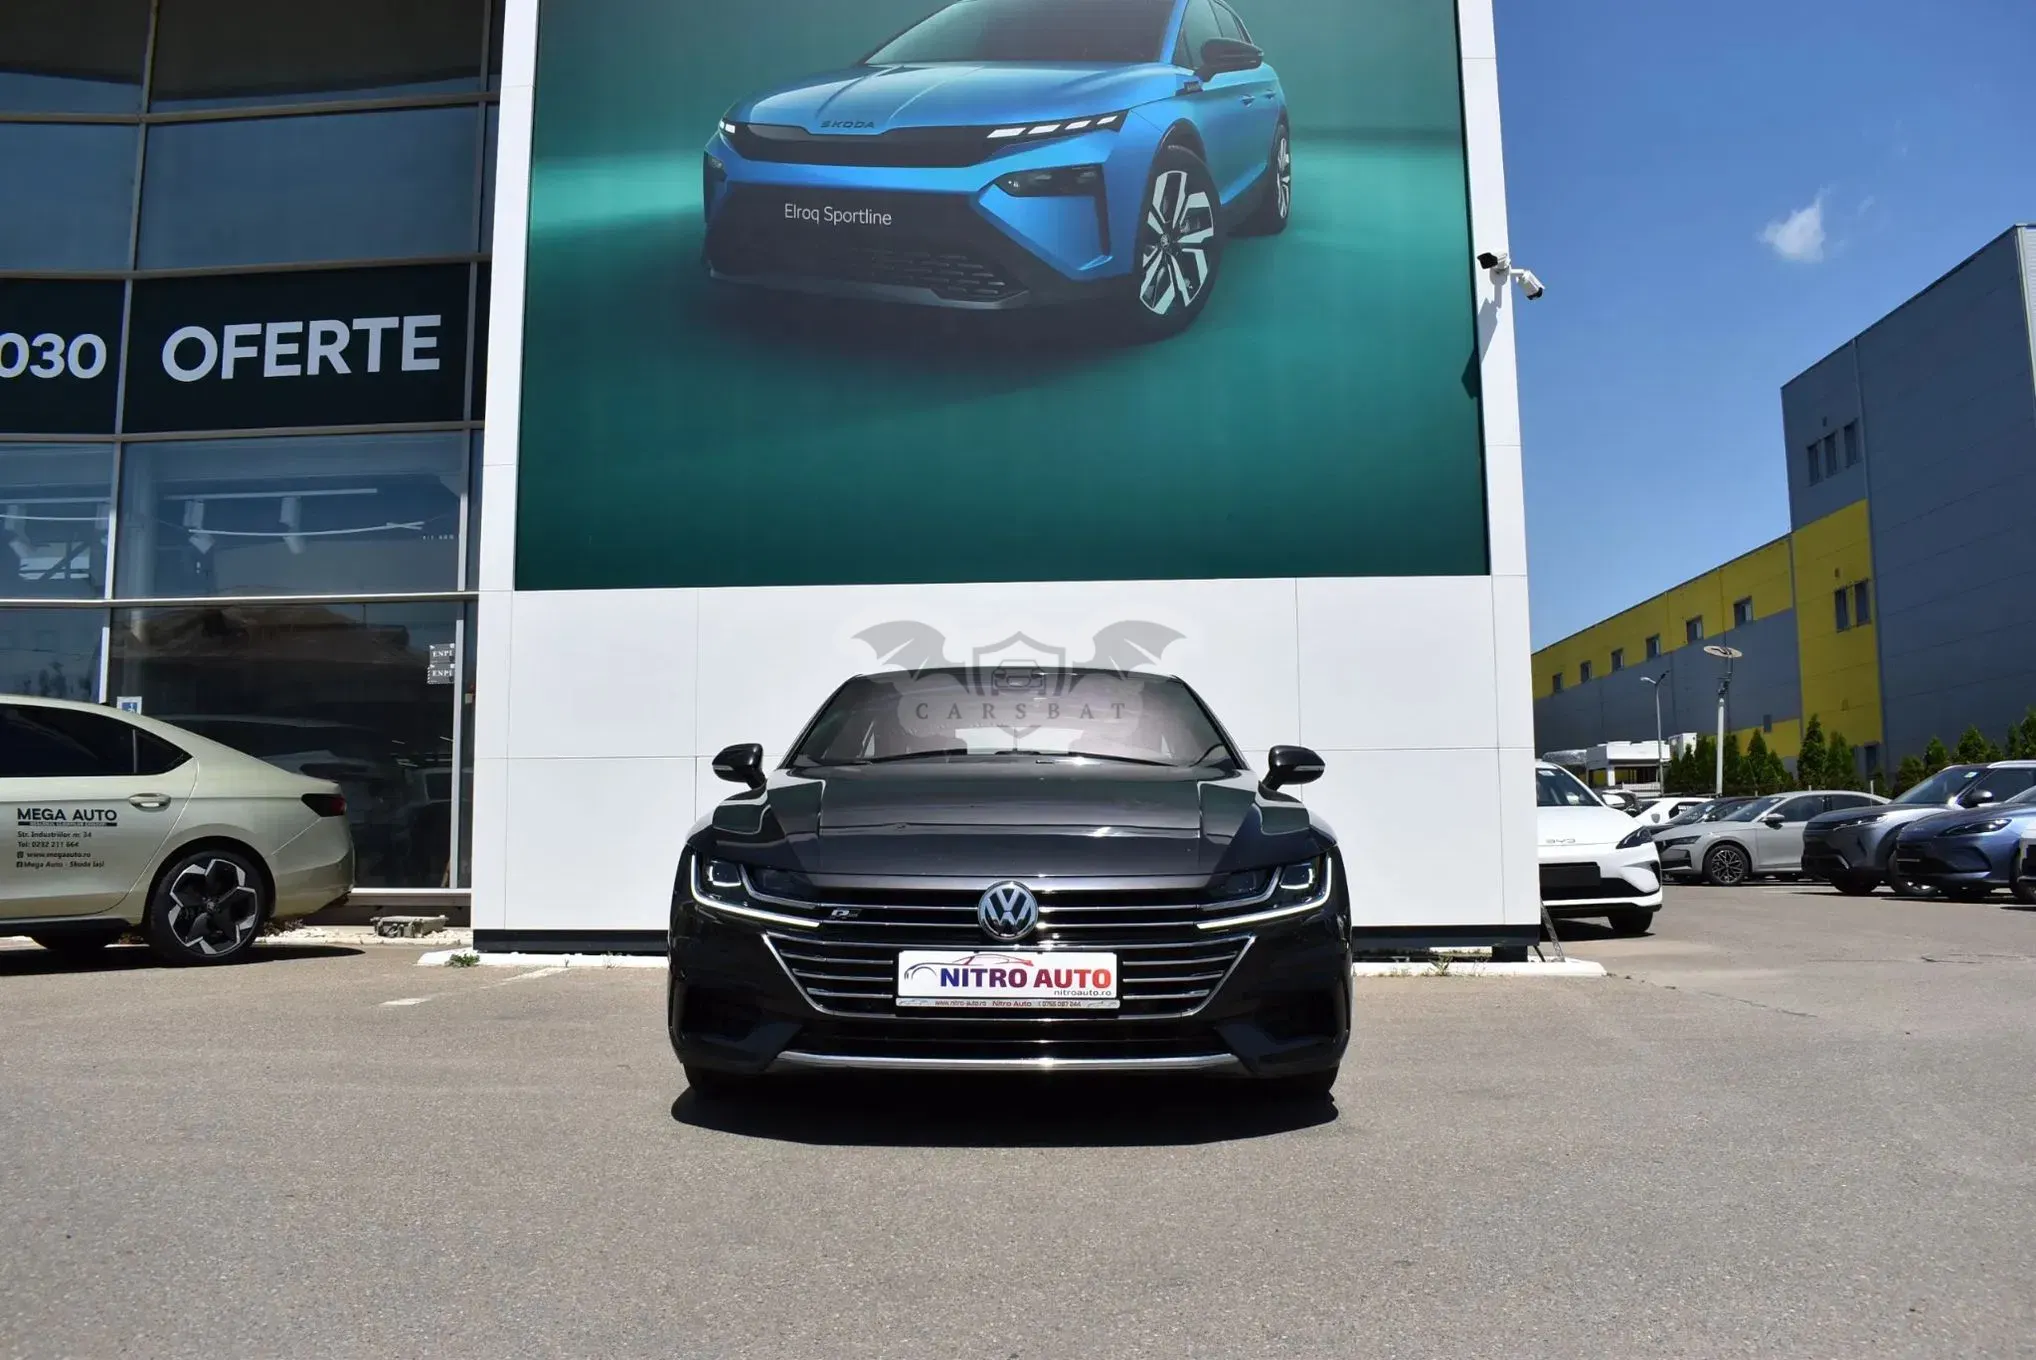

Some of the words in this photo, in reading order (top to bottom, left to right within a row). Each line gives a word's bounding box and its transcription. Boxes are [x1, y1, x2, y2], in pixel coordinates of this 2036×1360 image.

[785, 203, 820, 225] Elroq
[823, 206, 892, 226] Sportline
[161, 314, 442, 383] OFERTE
[17, 808, 67, 820] MEGA
[72, 809, 118, 821] AUTO
[940, 968, 1028, 988] NITRO
[1033, 968, 1112, 989] AUTO
[1053, 989, 1112, 997] nitroauto.ro
